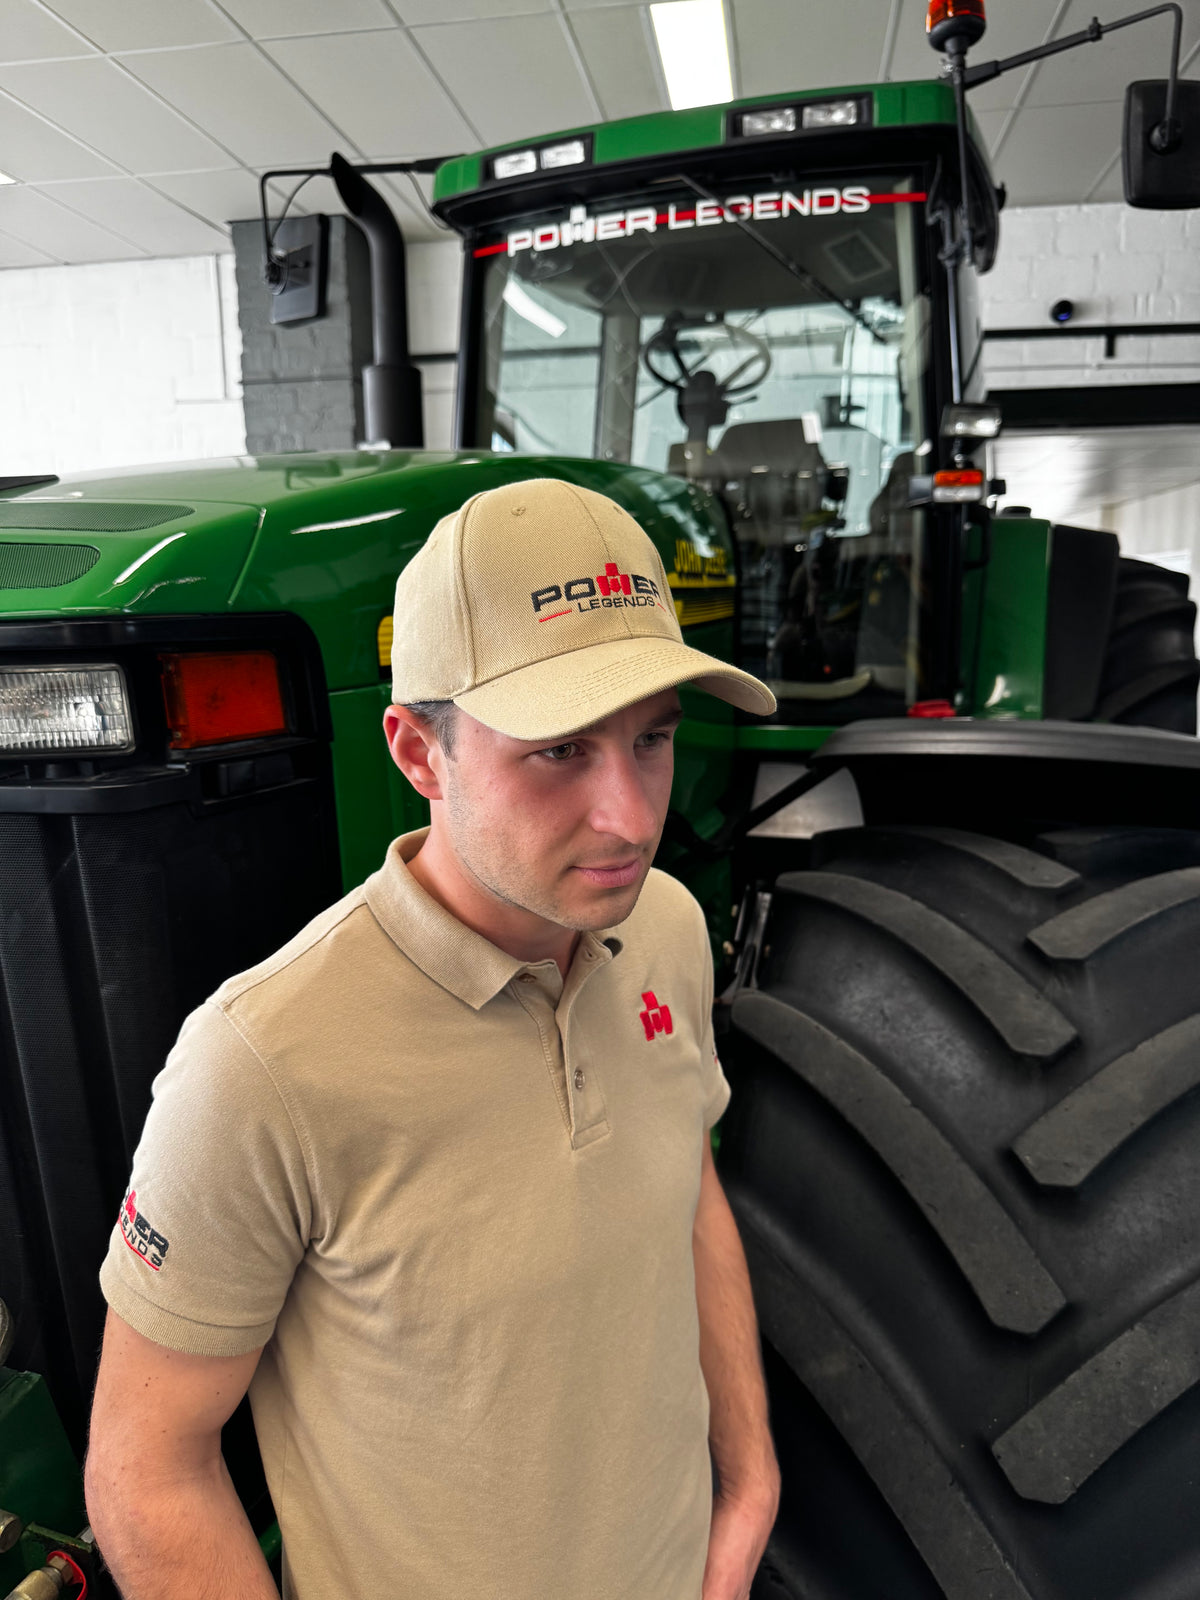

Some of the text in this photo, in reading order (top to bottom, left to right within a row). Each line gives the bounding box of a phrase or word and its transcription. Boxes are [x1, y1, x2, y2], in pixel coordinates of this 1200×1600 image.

[507, 186, 870, 257] POWER LEGENDS
[578, 596, 655, 612] LEGENDS
